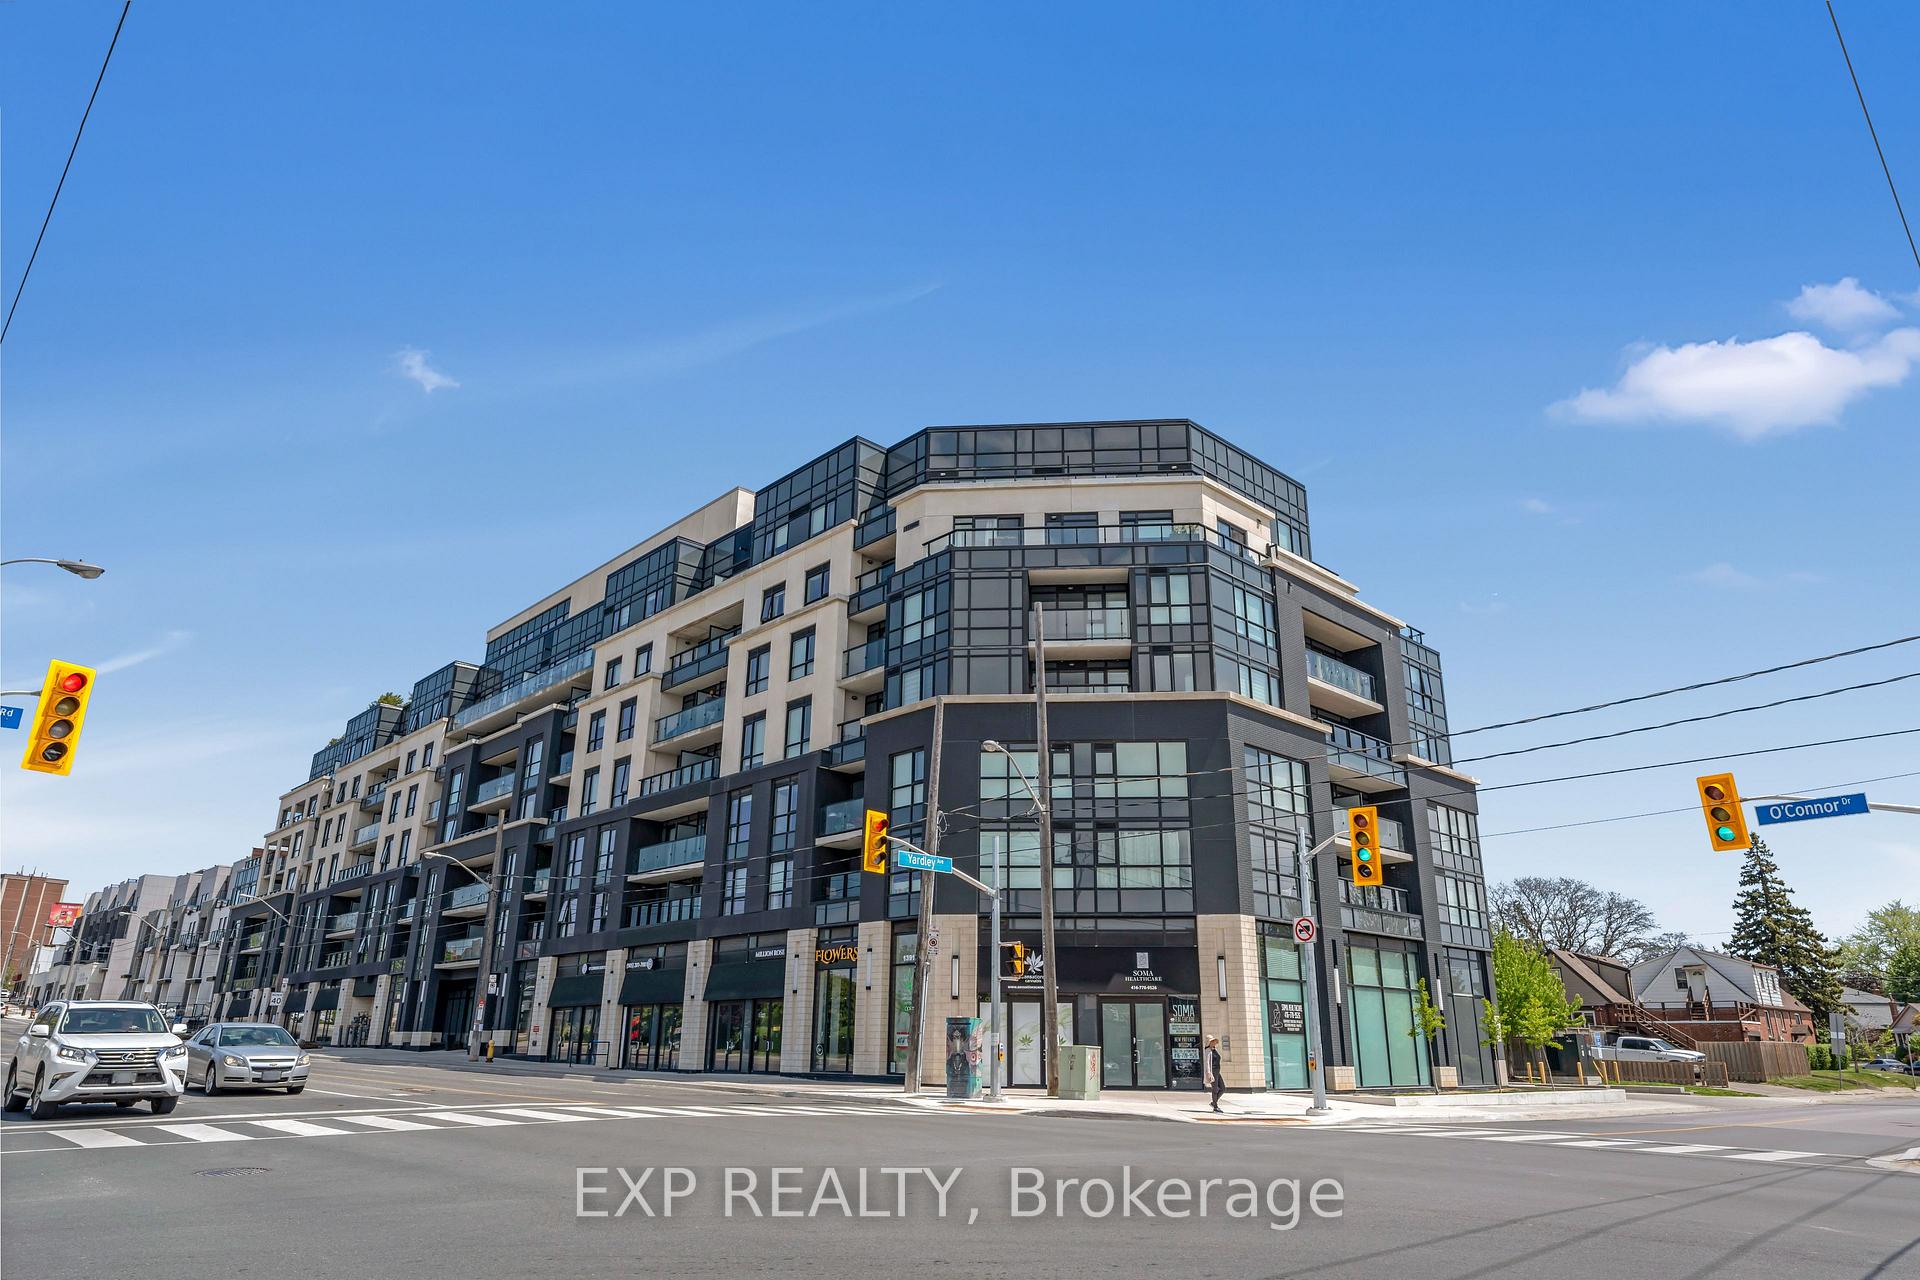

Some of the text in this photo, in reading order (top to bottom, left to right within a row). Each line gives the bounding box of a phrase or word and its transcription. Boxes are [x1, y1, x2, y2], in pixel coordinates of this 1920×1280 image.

[1, 708, 14, 717] Rd
[1769, 797, 1851, 819] O'Connor Dr
[908, 854, 936, 870] Yardley
[755, 949, 773, 958] MILLION
[815, 945, 859, 965] FLOWERS
[271, 997, 282, 1005] 40
[1172, 1004, 1195, 1017] SOMA
